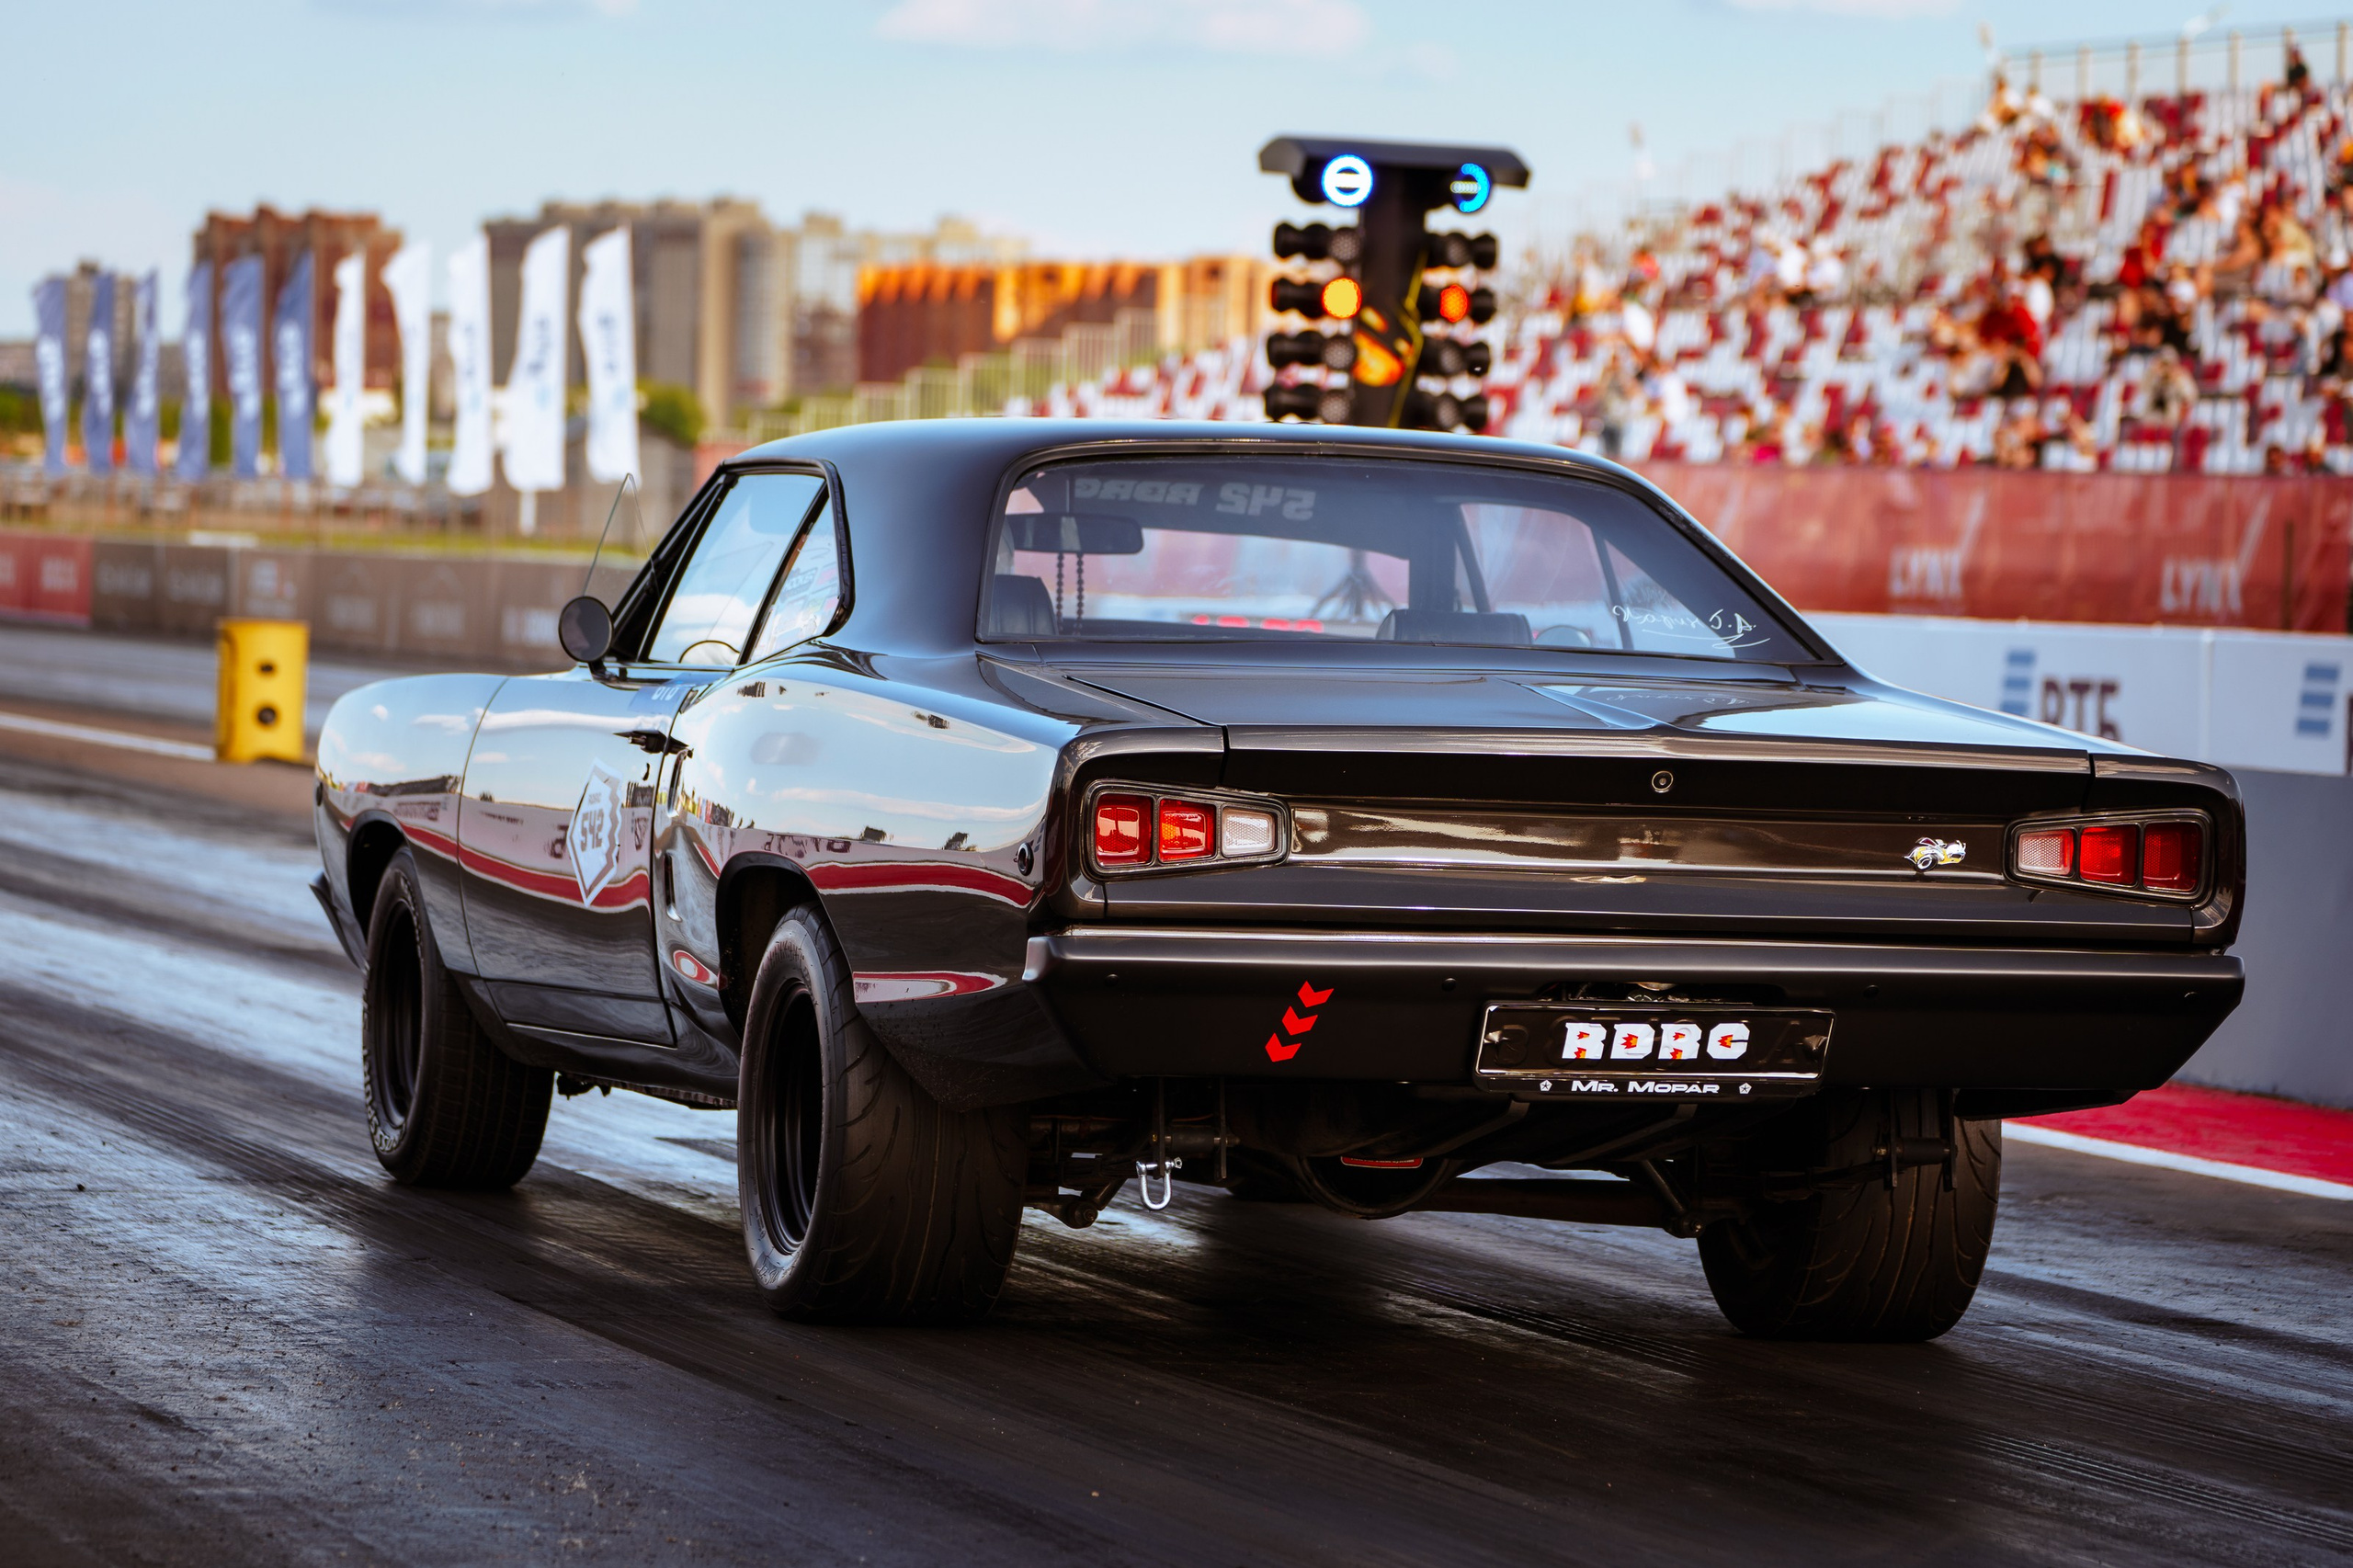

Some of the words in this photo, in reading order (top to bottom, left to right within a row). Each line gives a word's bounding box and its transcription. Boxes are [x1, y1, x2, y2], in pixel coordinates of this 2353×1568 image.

[580, 809, 604, 852] 542
[1562, 1022, 1750, 1060] RDRC
[1628, 1081, 1721, 1094] MOPAR
